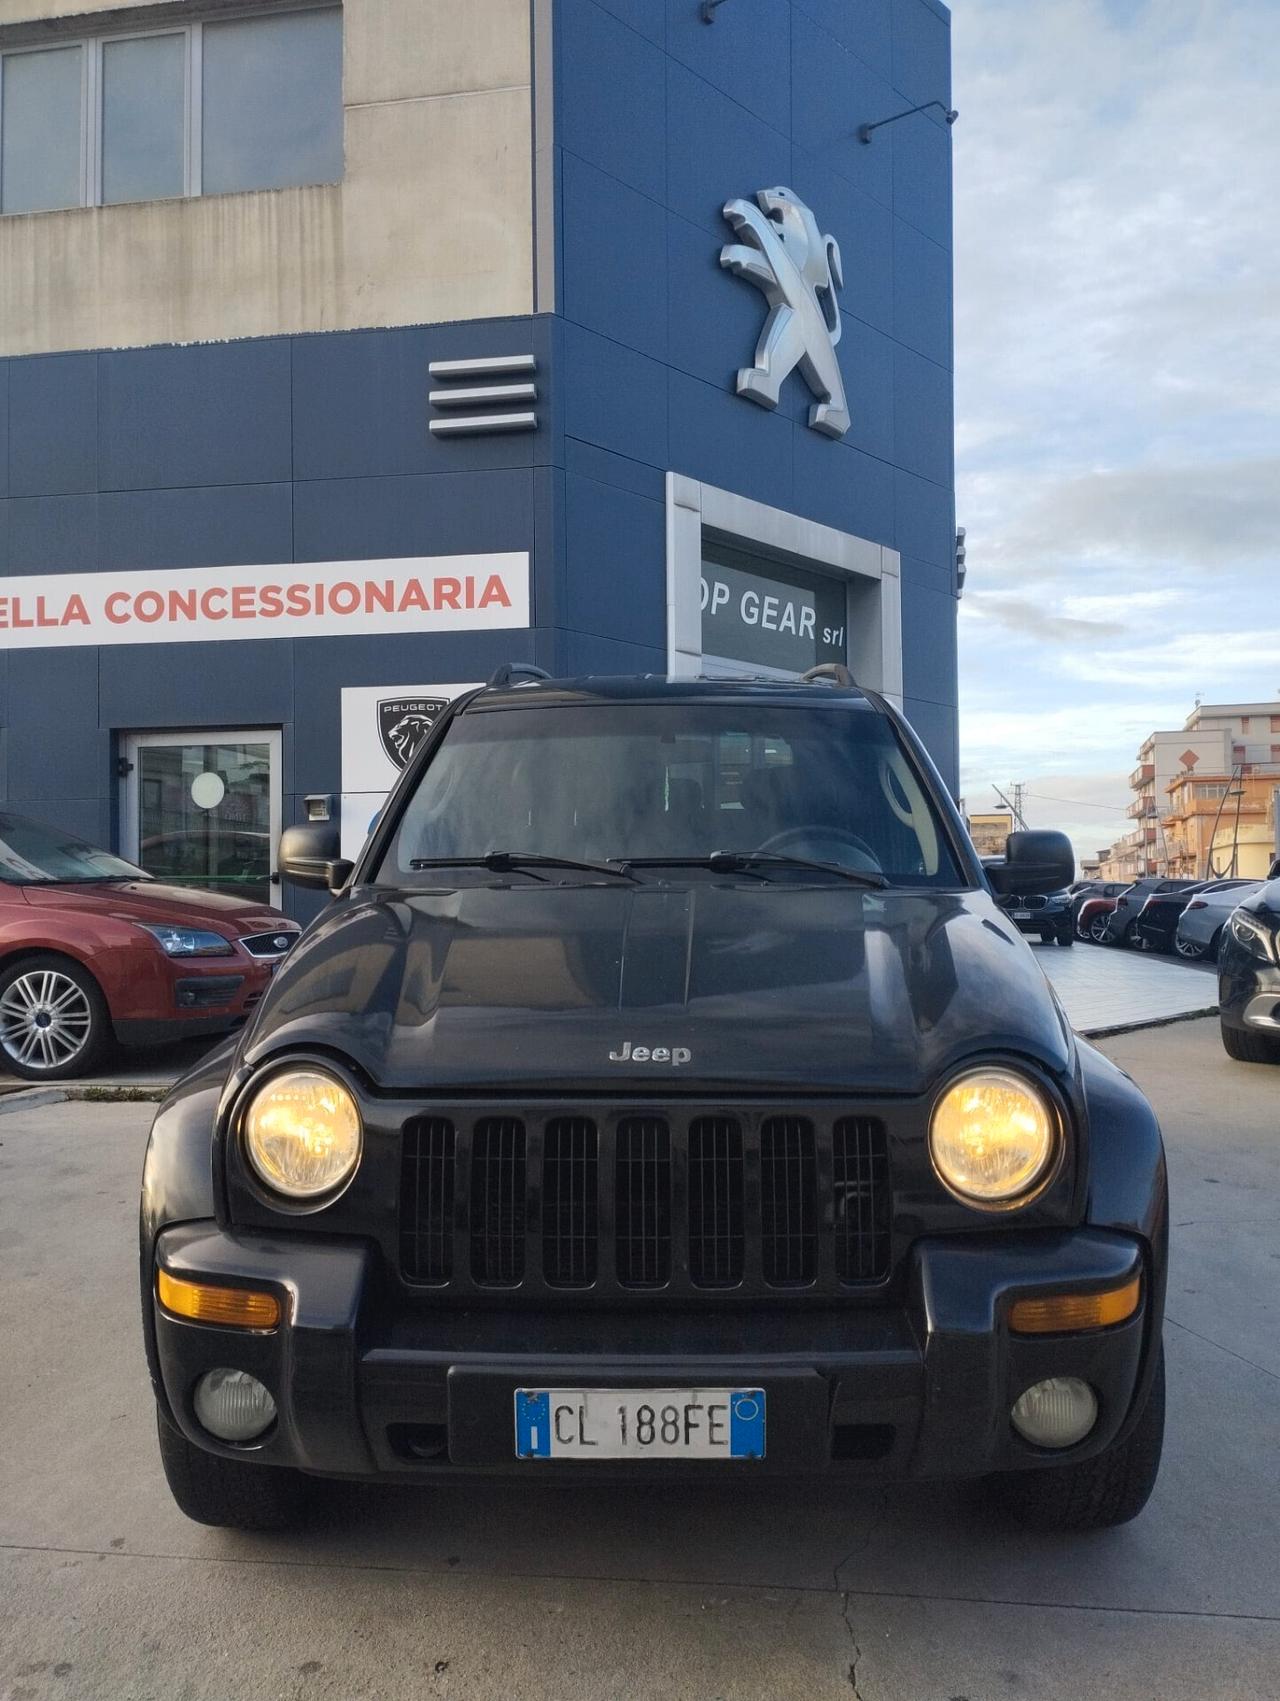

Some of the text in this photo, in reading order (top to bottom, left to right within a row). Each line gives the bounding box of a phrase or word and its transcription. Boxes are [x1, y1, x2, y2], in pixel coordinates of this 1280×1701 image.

[104, 574, 512, 625] CONCESSIONARIA
[740, 591, 816, 640] GEAR
[823, 627, 844, 647] srl
[384, 704, 443, 712] PEUGEOT
[609, 1042, 691, 1066] Jeep
[554, 1404, 729, 1446] CL 188FE
